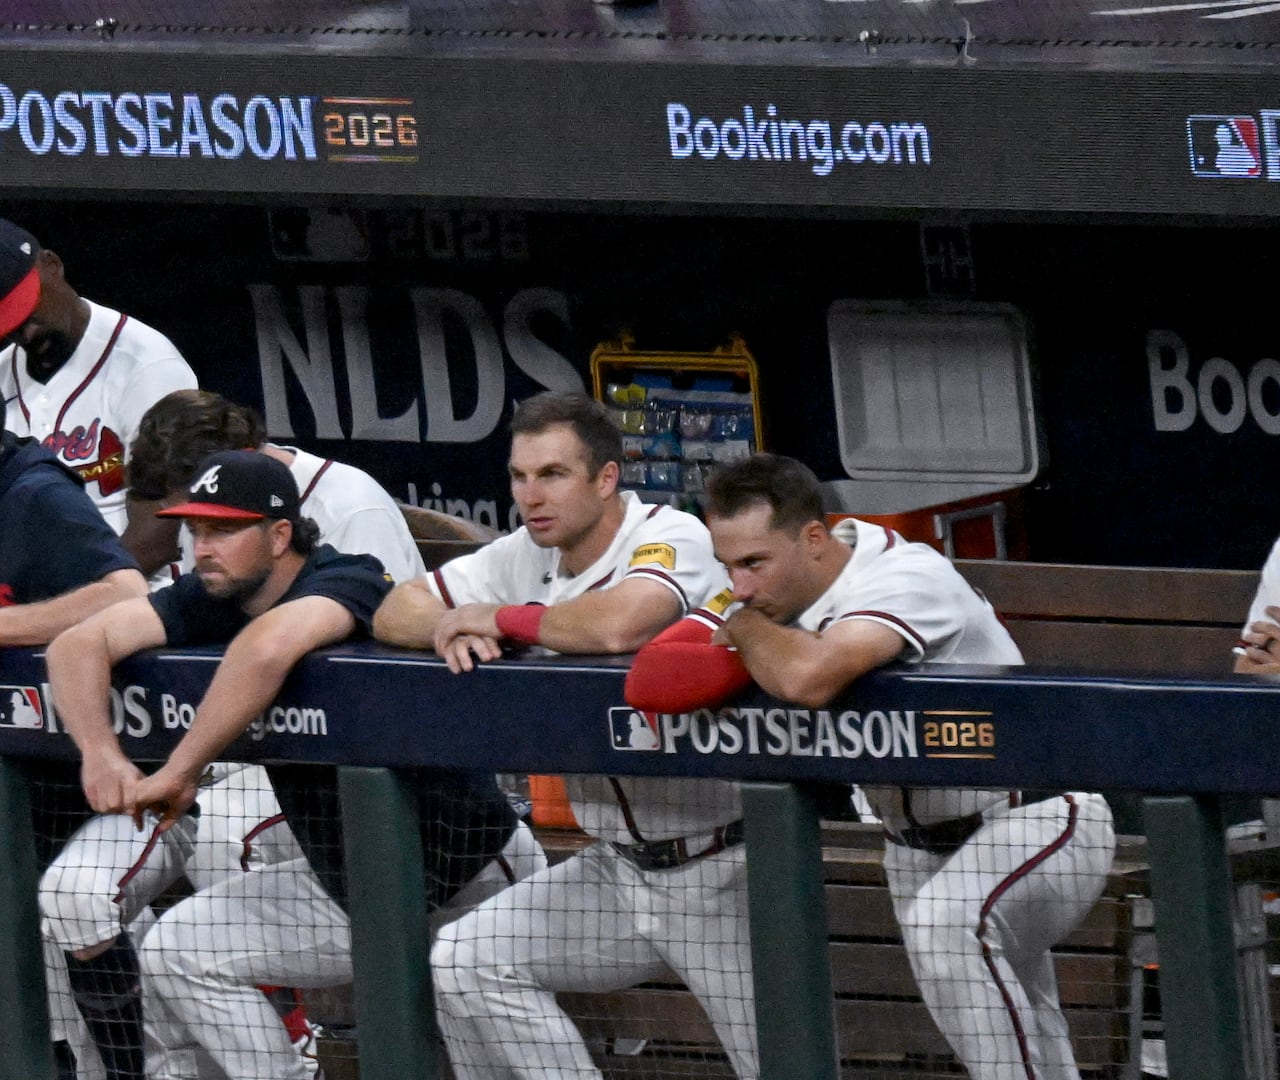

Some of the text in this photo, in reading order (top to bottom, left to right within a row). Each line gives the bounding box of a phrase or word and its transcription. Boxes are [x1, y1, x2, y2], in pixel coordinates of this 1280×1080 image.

[324, 111, 419, 148] 2026
[667, 103, 931, 176] Booking.com
[662, 706, 996, 758] POSTSEASON 2026
